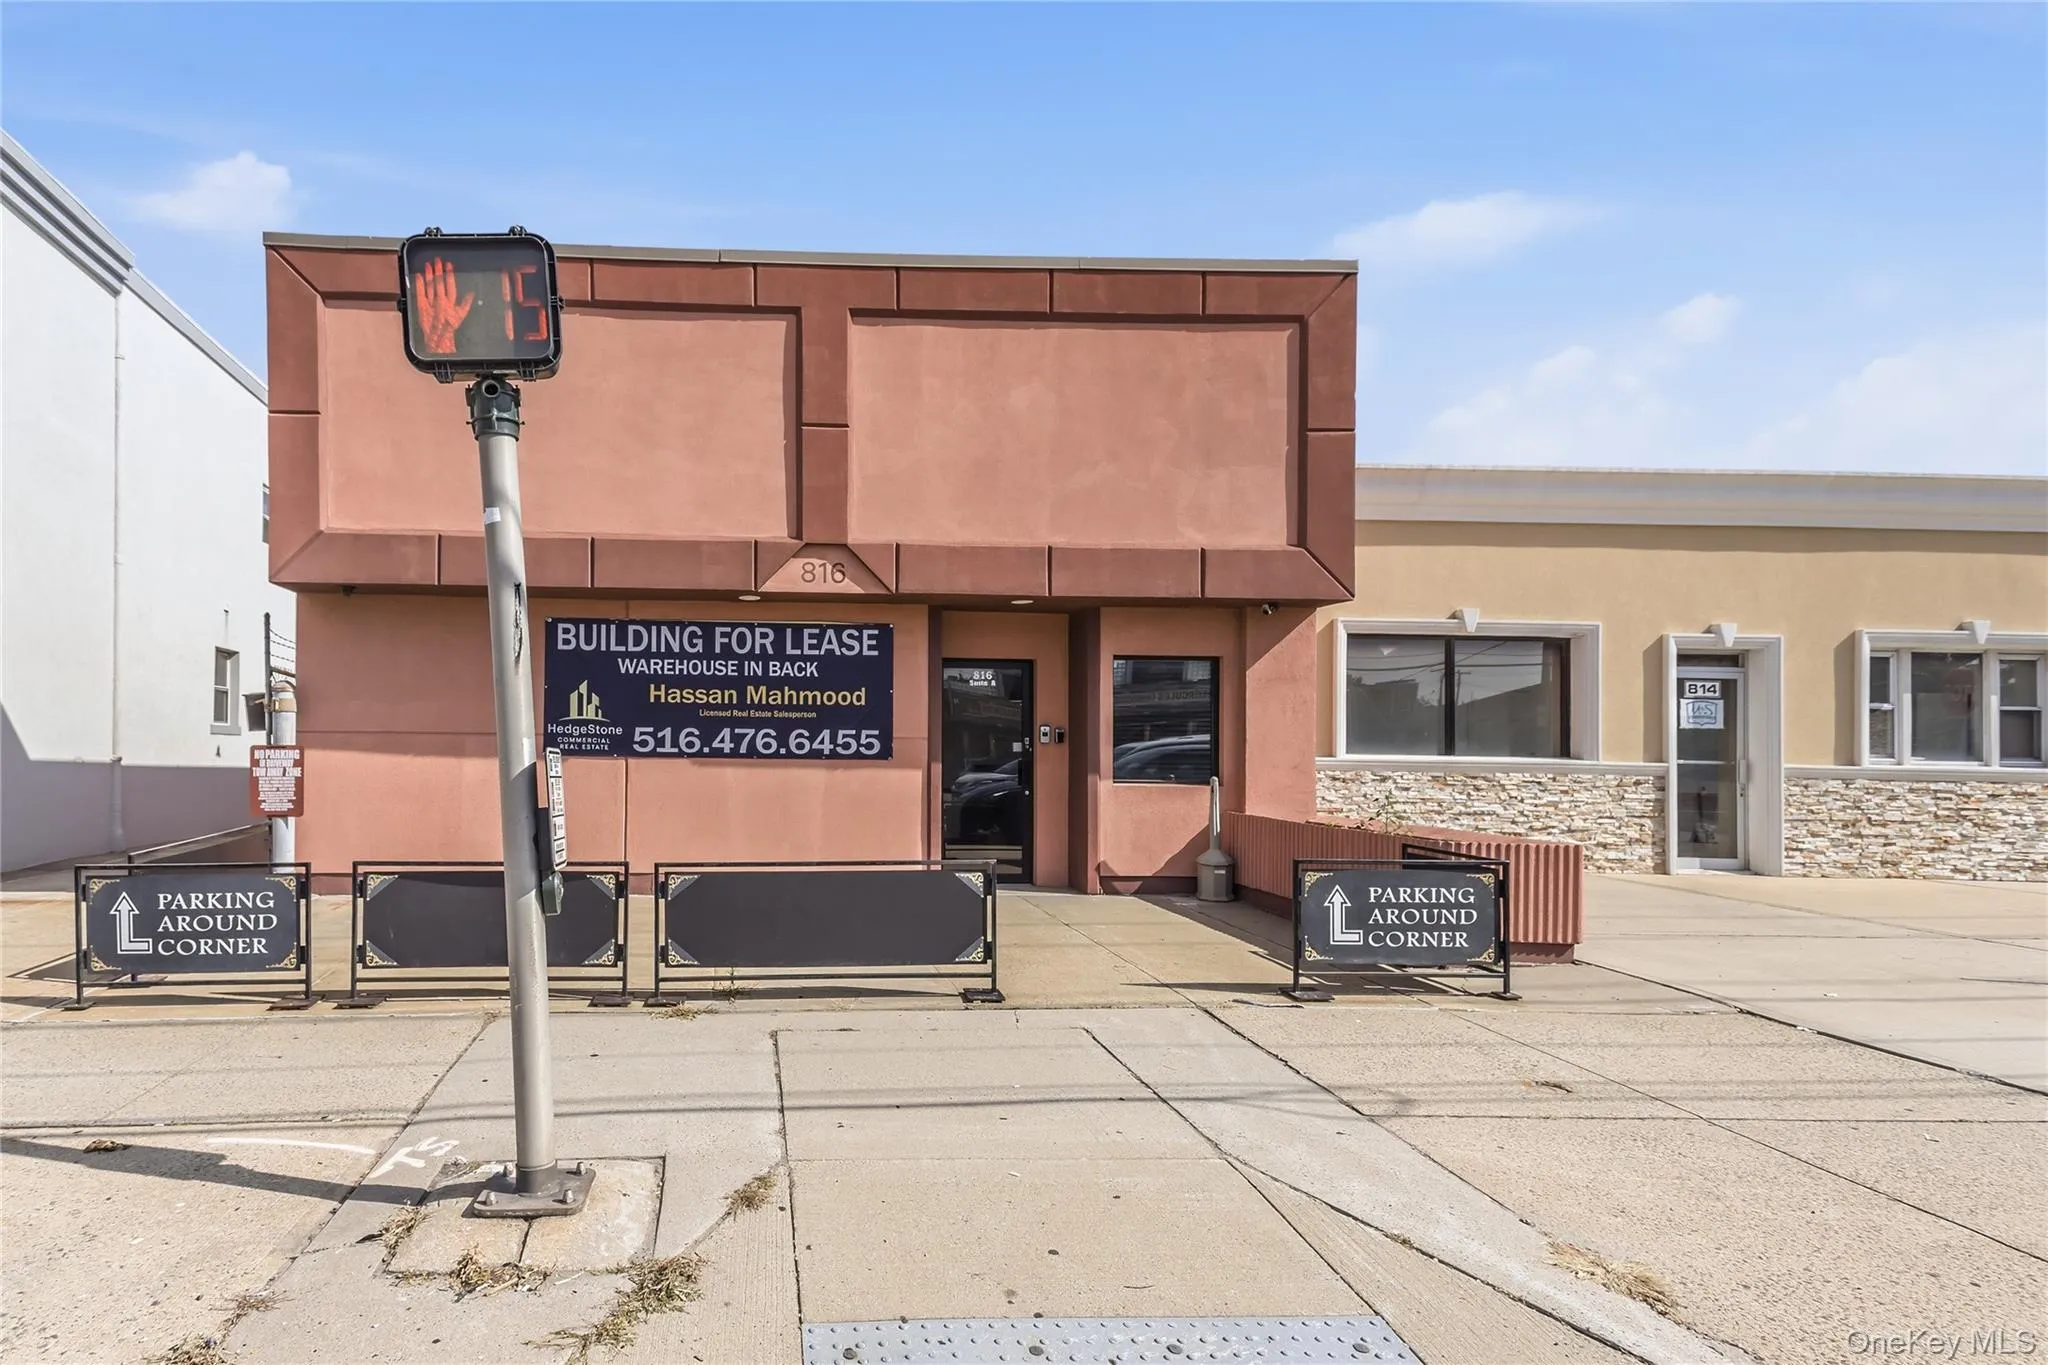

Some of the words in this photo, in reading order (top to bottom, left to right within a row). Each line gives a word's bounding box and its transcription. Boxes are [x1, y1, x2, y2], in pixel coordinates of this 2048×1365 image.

[501, 265, 548, 341] 15
[801, 562, 846, 583] 816
[556, 623, 703, 653] BUILDING
[714, 626, 774, 656] FOR
[786, 628, 879, 657] LEASE
[618, 658, 738, 675] WAREHOUSE
[744, 660, 762, 676] IN
[769, 661, 819, 677] BACK
[973, 670, 993, 680] 816
[650, 683, 737, 704] Hassan
[746, 685, 866, 706] Mahmood
[1688, 683, 1717, 695] 814
[699, 709, 731, 717] Licensed
[733, 710, 748, 718] Real
[750, 710, 772, 718] Estate
[773, 710, 817, 720] Salesperson
[547, 723, 623, 736] HedgeStone
[632, 727, 881, 755] 516.476.6455
[254, 749, 265, 759] NO
[265, 749, 300, 760] PARKING
[252, 767, 266, 777] TOW
[285, 767, 302, 777] ZONE
[157, 891, 275, 910] PARKING
[1368, 887, 1476, 904] PARKING
[157, 914, 278, 932] AROUND
[1368, 908, 1478, 925] AROUND
[157, 937, 269, 956] CORNER
[1368, 931, 1469, 948] CORNER
